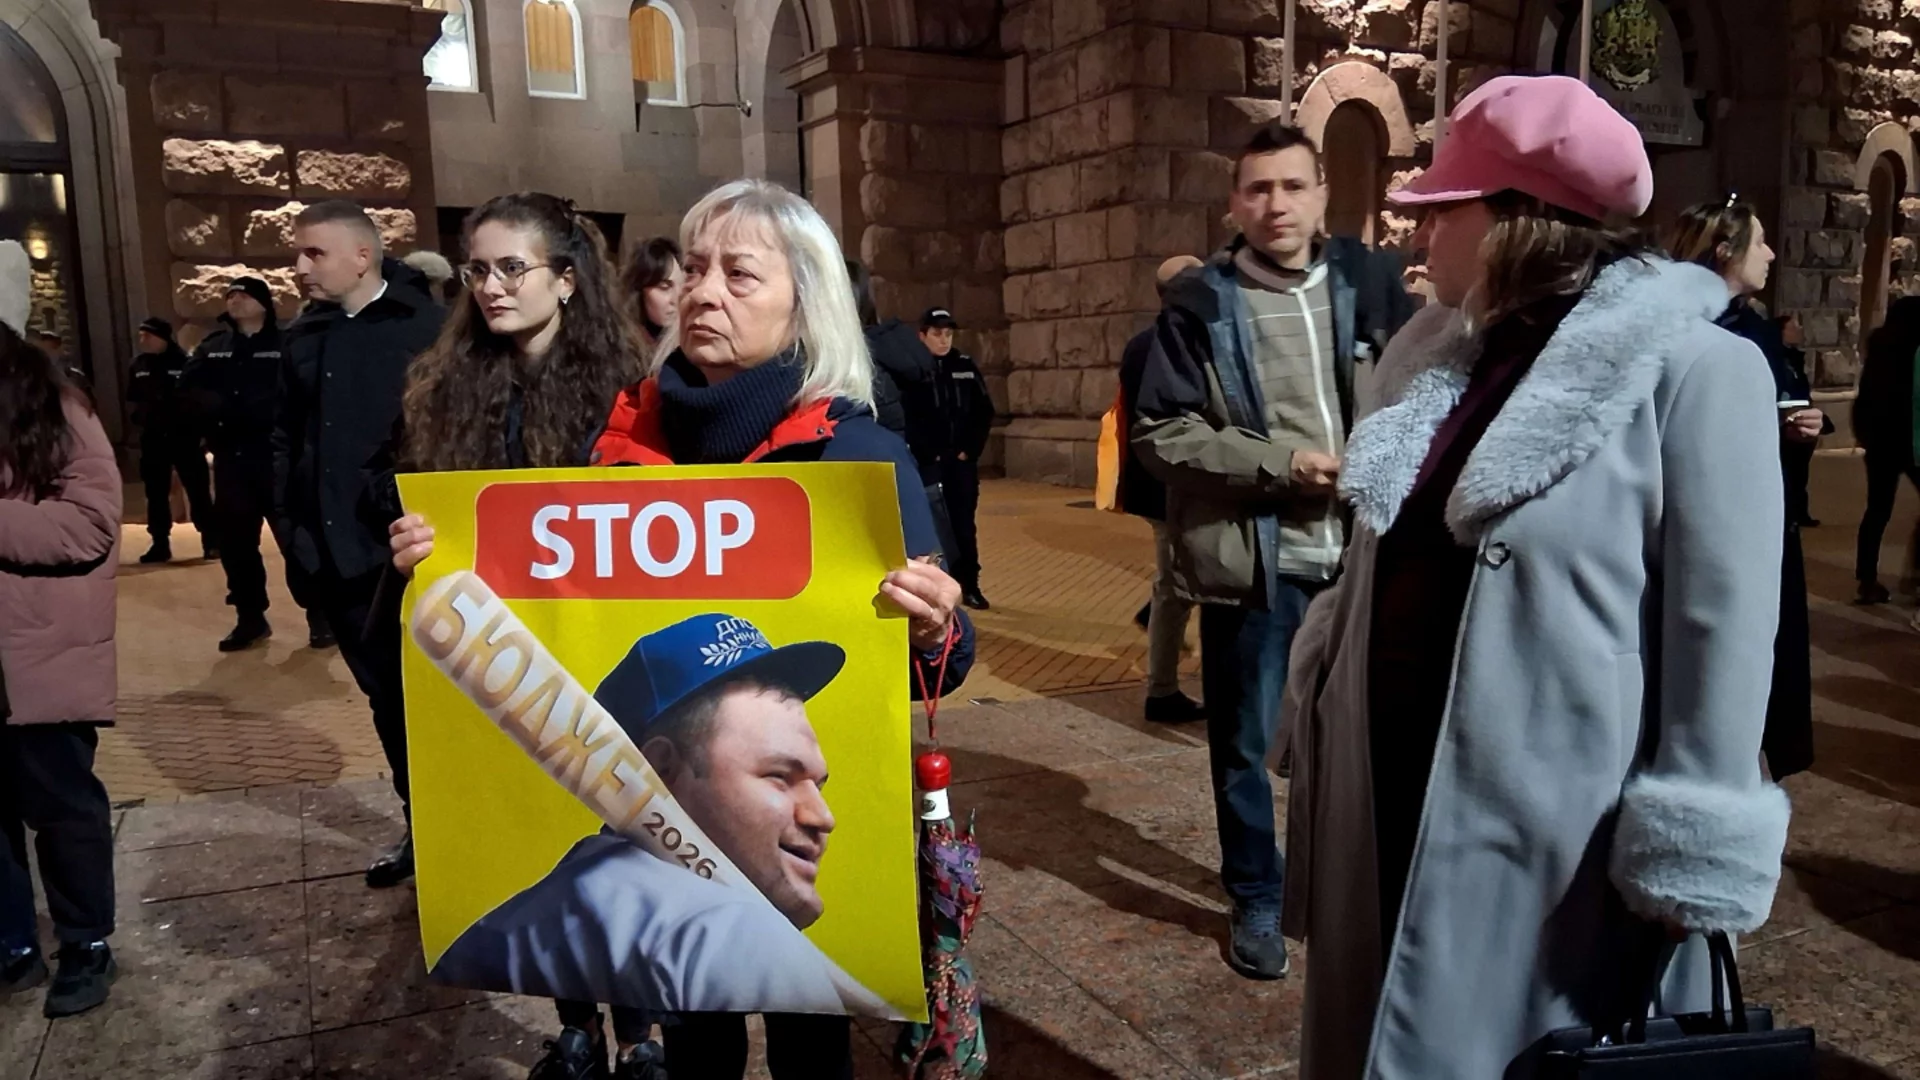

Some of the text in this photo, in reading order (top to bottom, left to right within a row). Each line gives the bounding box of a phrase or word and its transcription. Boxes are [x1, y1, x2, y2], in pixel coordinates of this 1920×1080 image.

[529, 499, 756, 580] STOP
[412, 571, 673, 833] БЮДЖЕТ
[642, 811, 717, 880] 2026
